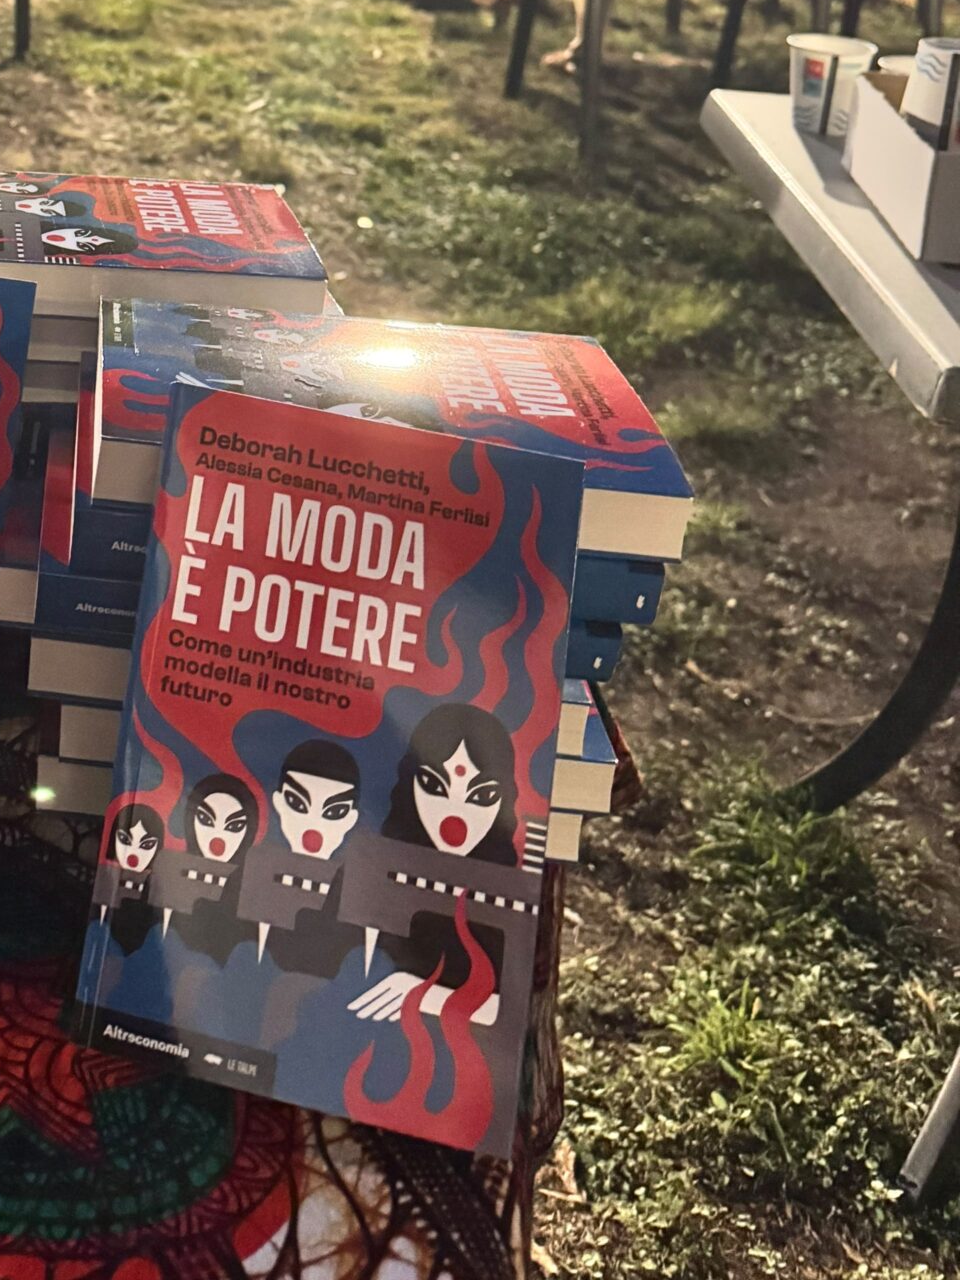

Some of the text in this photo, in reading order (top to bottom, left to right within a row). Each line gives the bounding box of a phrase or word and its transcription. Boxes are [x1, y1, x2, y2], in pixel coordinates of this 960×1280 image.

[132, 188, 190, 233] POTERE
[179, 183, 243, 235] LA MODA
[494, 357, 576, 417] MODA
[195, 452, 490, 528] Alessia Cesana, Martina Ferlisi
[199, 425, 431, 496] Deborah Lucchetti,
[184, 474, 425, 590] LA MODA
[171, 541, 422, 674] È POTERE
[163, 655, 352, 710] modella il nostro
[168, 628, 375, 691] Come un'industria
[160, 675, 233, 708] futuro
[103, 1024, 190, 1059] Altreconomia
